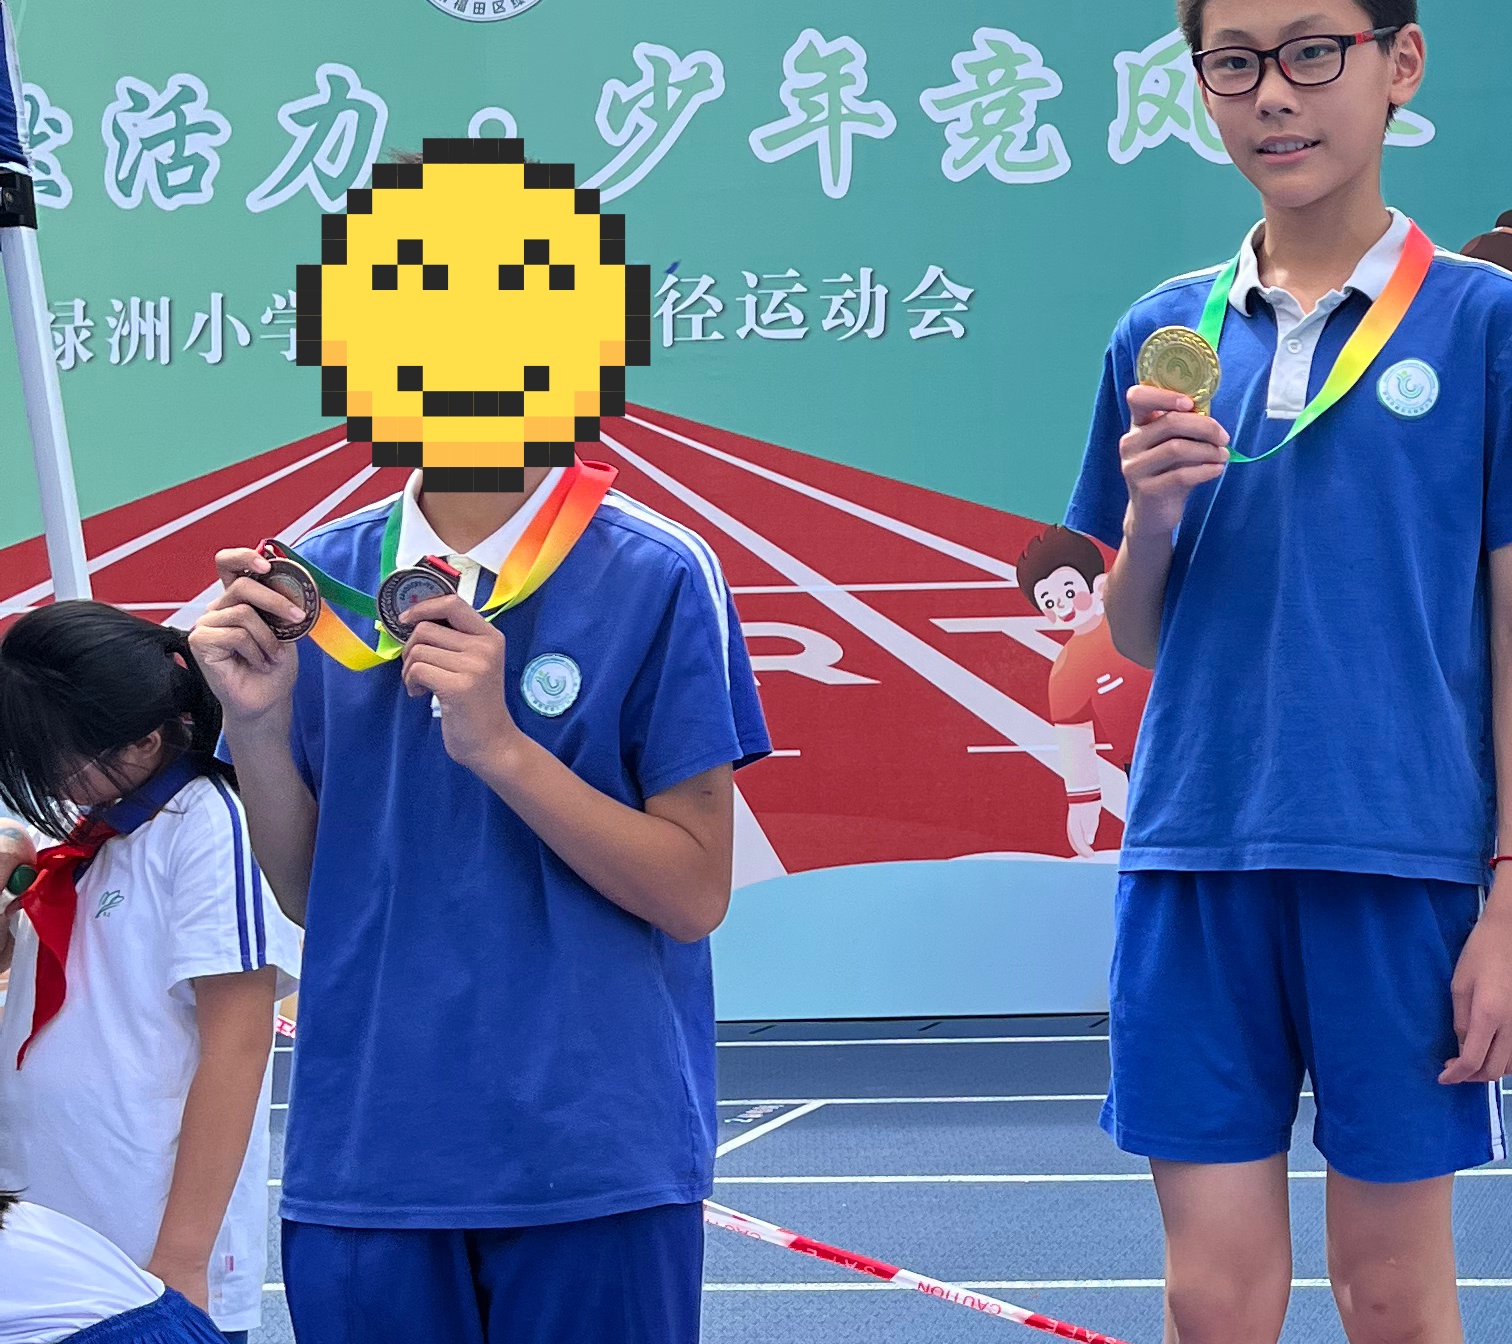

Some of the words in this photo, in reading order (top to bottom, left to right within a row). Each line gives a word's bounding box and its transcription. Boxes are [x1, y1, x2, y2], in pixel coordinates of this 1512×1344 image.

[653, 265, 975, 348] 径运动会
[917, 1281, 1002, 1316] CAUTION
